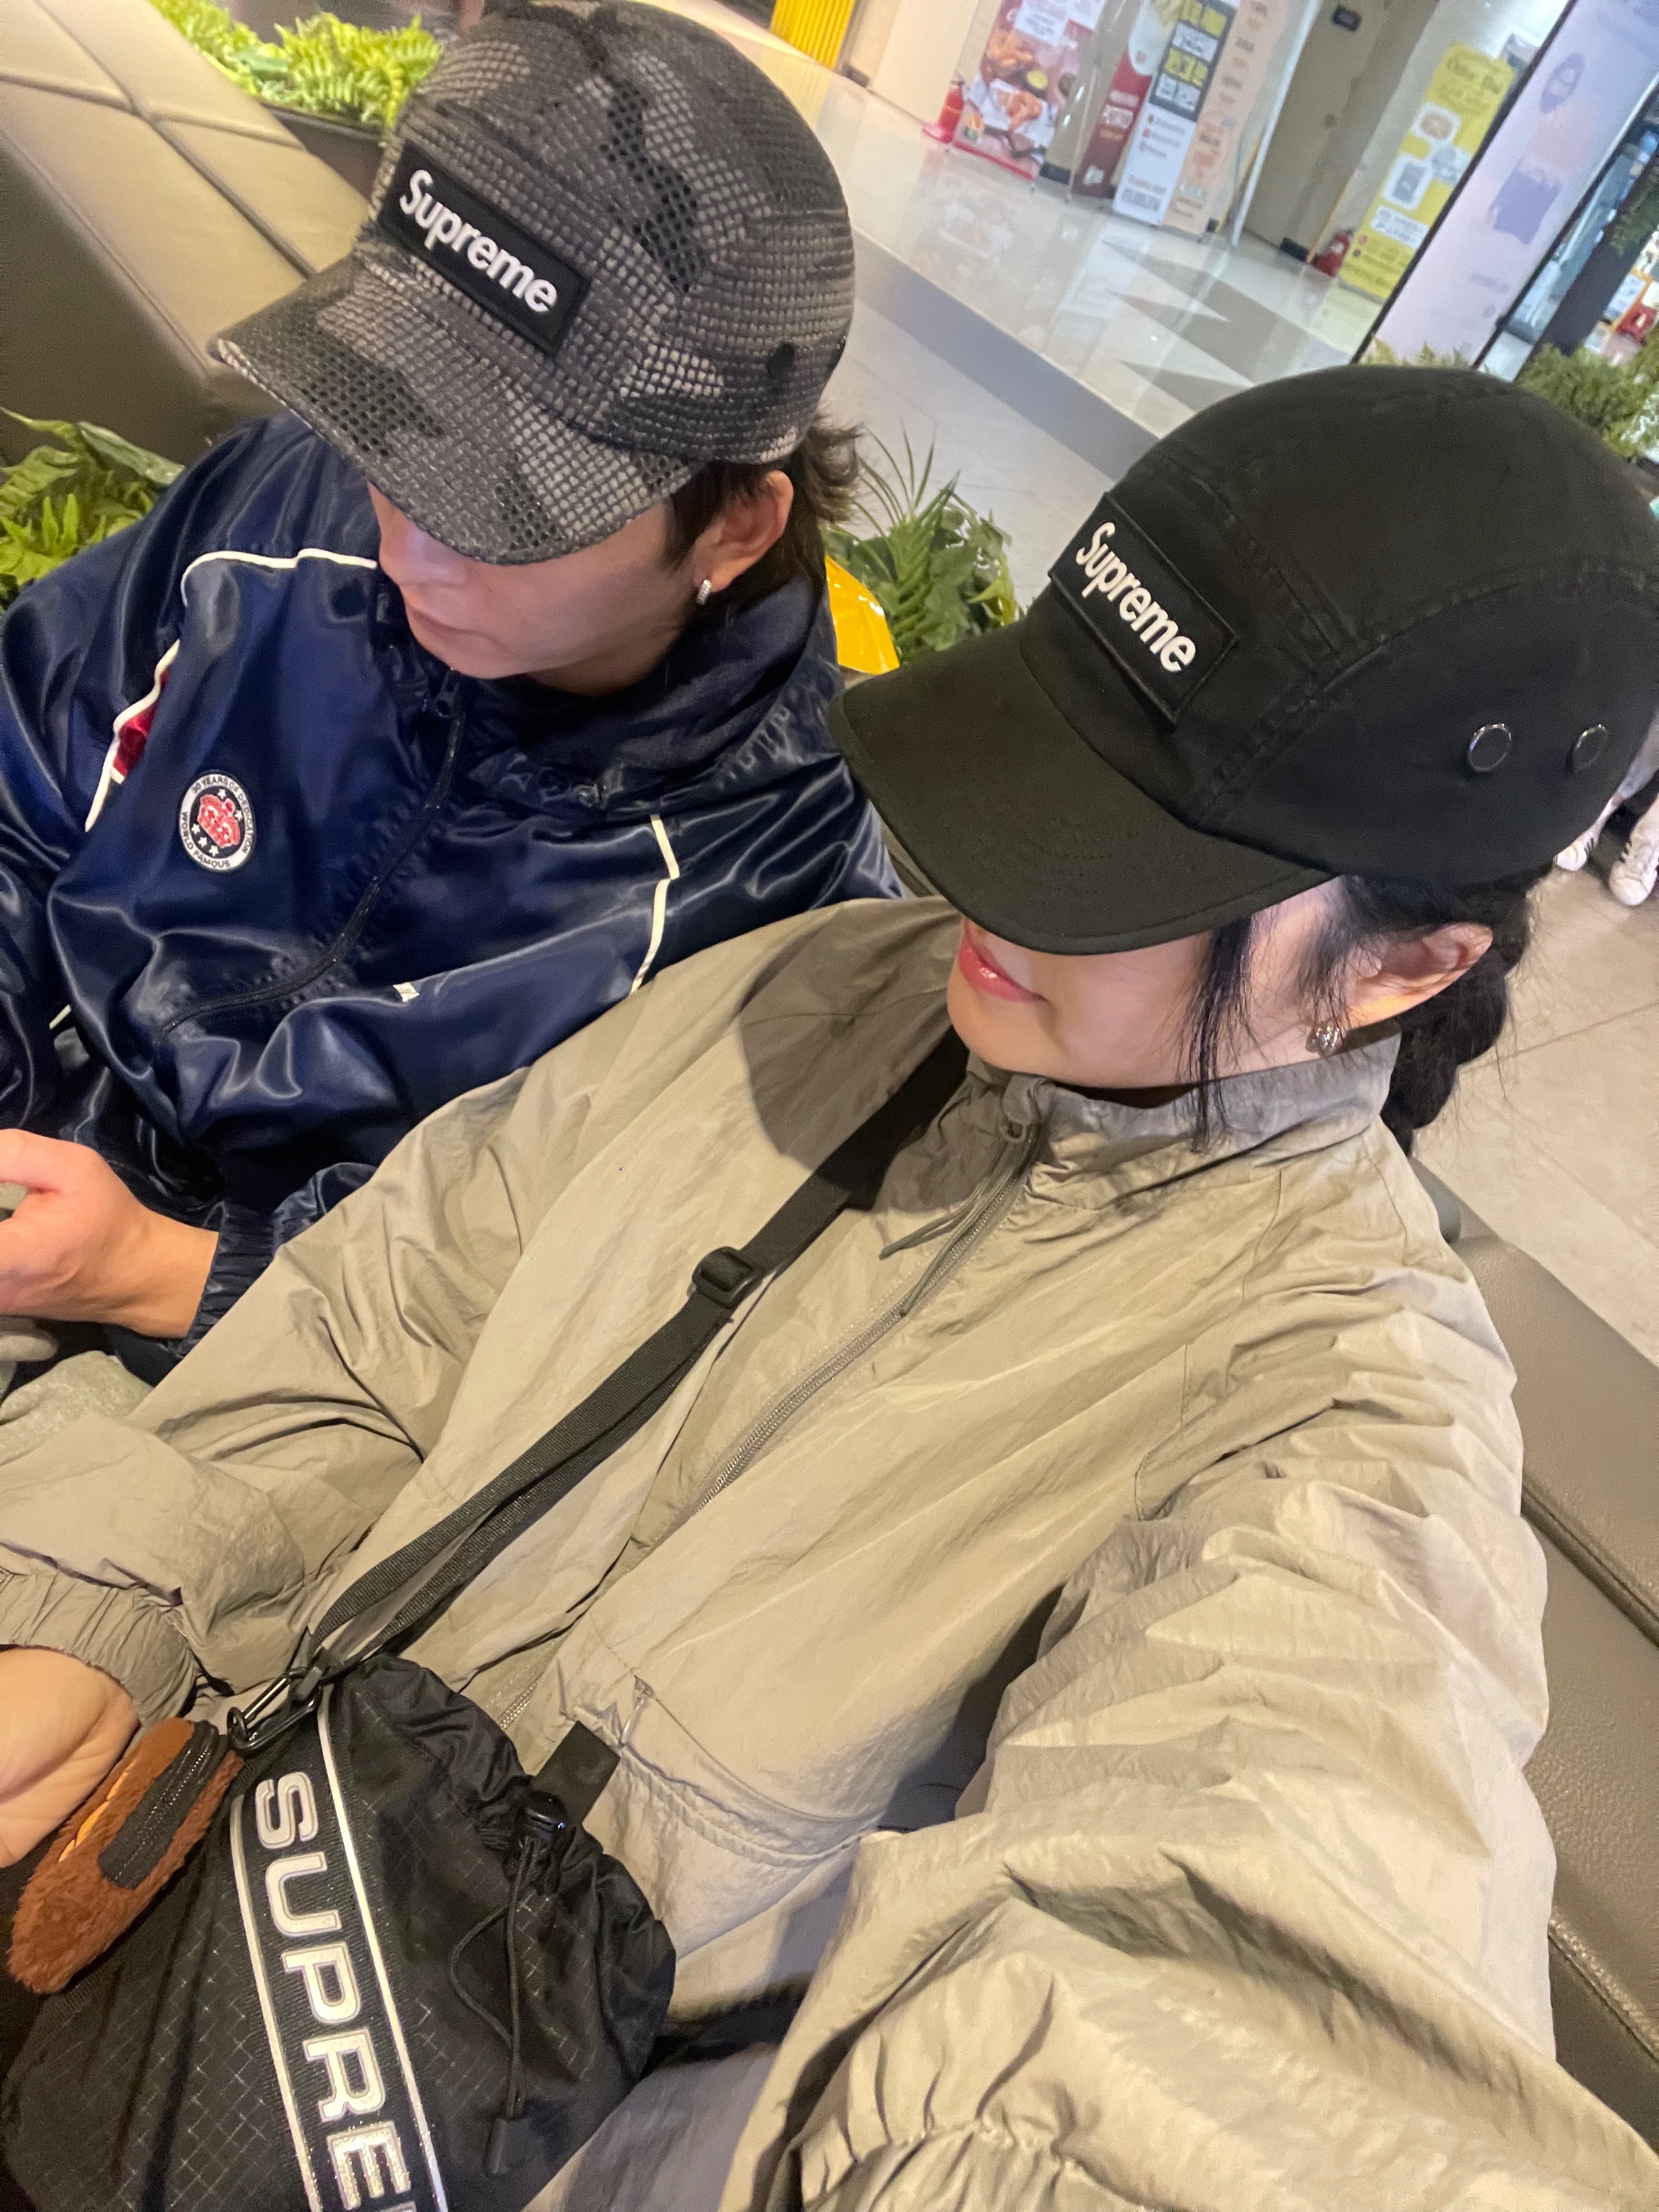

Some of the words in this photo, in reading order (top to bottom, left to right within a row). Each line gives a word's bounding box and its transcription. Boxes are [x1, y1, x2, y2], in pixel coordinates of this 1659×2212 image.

[399, 169, 558, 313] Supreme
[1076, 521, 1196, 673] Supreme
[181, 812, 193, 850] WORLD
[194, 850, 230, 867] FAMOUS
[203, 776, 228, 786] YEARS
[229, 781, 240, 792] OF
[255, 1771, 417, 2212] SUPRE
